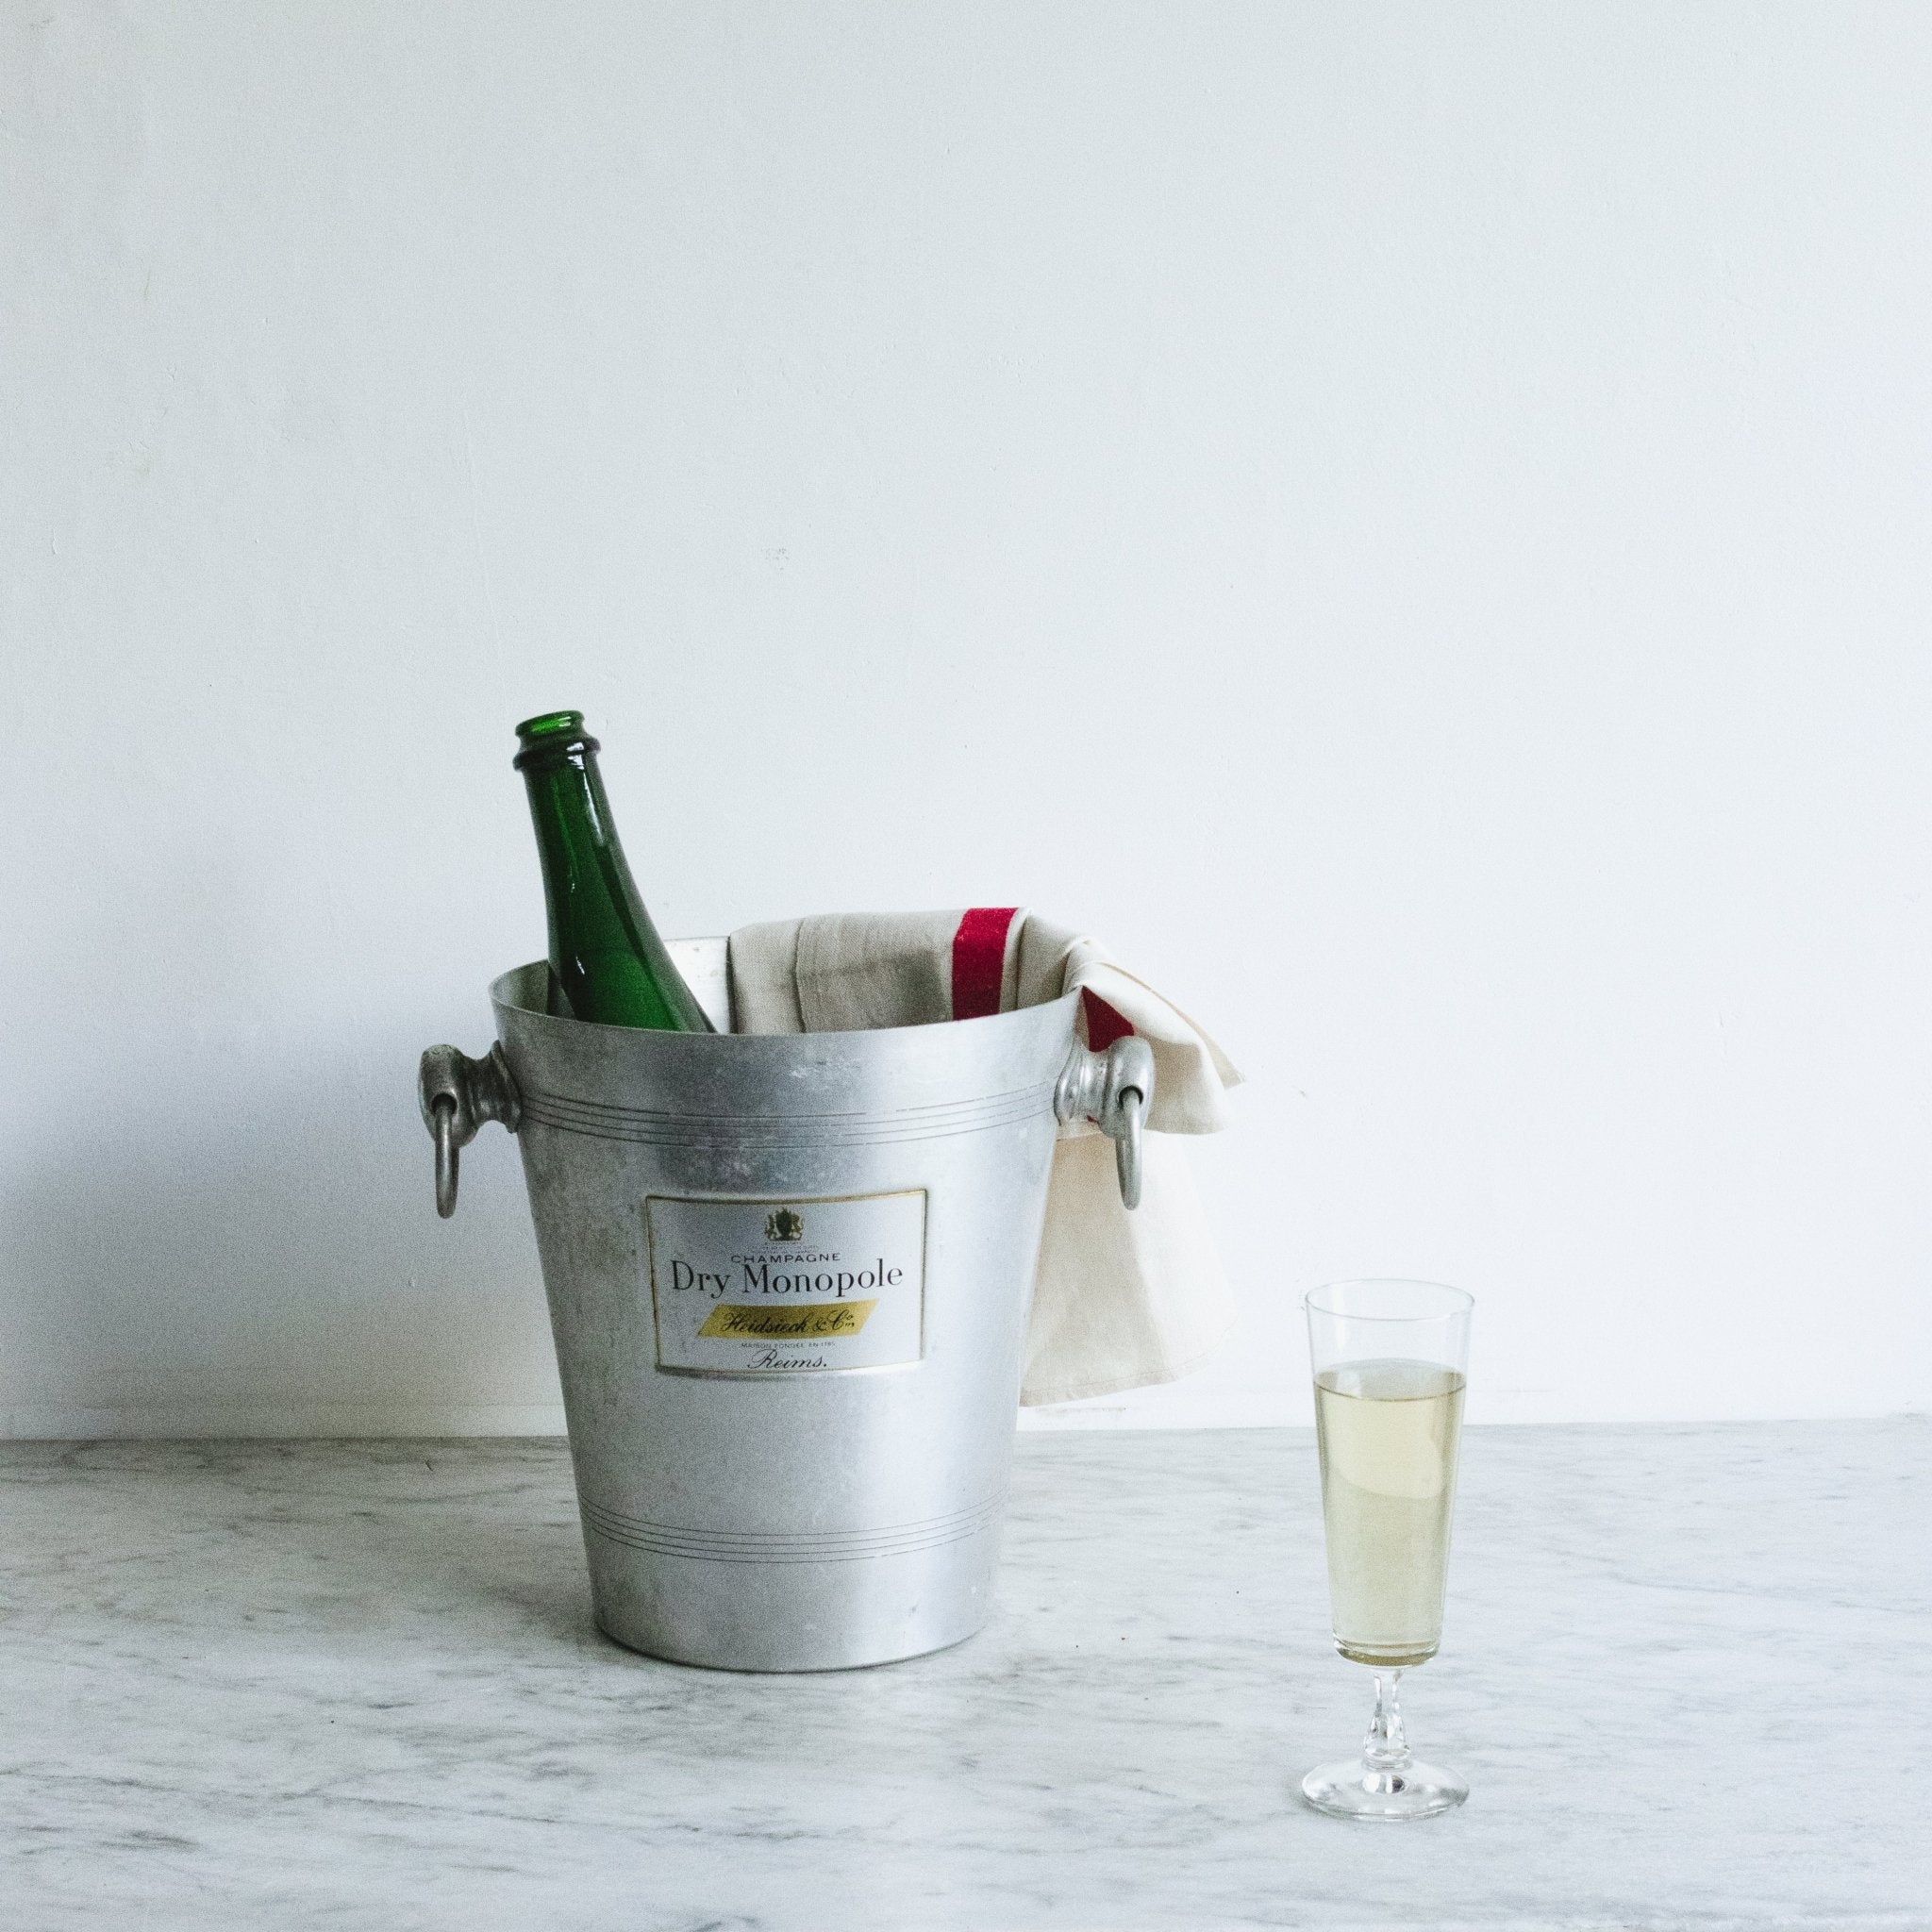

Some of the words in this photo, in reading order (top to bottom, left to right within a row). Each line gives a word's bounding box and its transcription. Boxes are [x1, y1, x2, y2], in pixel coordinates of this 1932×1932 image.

[730, 1253, 841, 1264] CHAMPAGNE
[672, 1259, 731, 1298] Dry
[743, 1257, 903, 1297] Monopole
[721, 1309, 809, 1334] Heidsieck
[812, 1316, 830, 1332] &
[746, 1349, 828, 1369] Reims.
